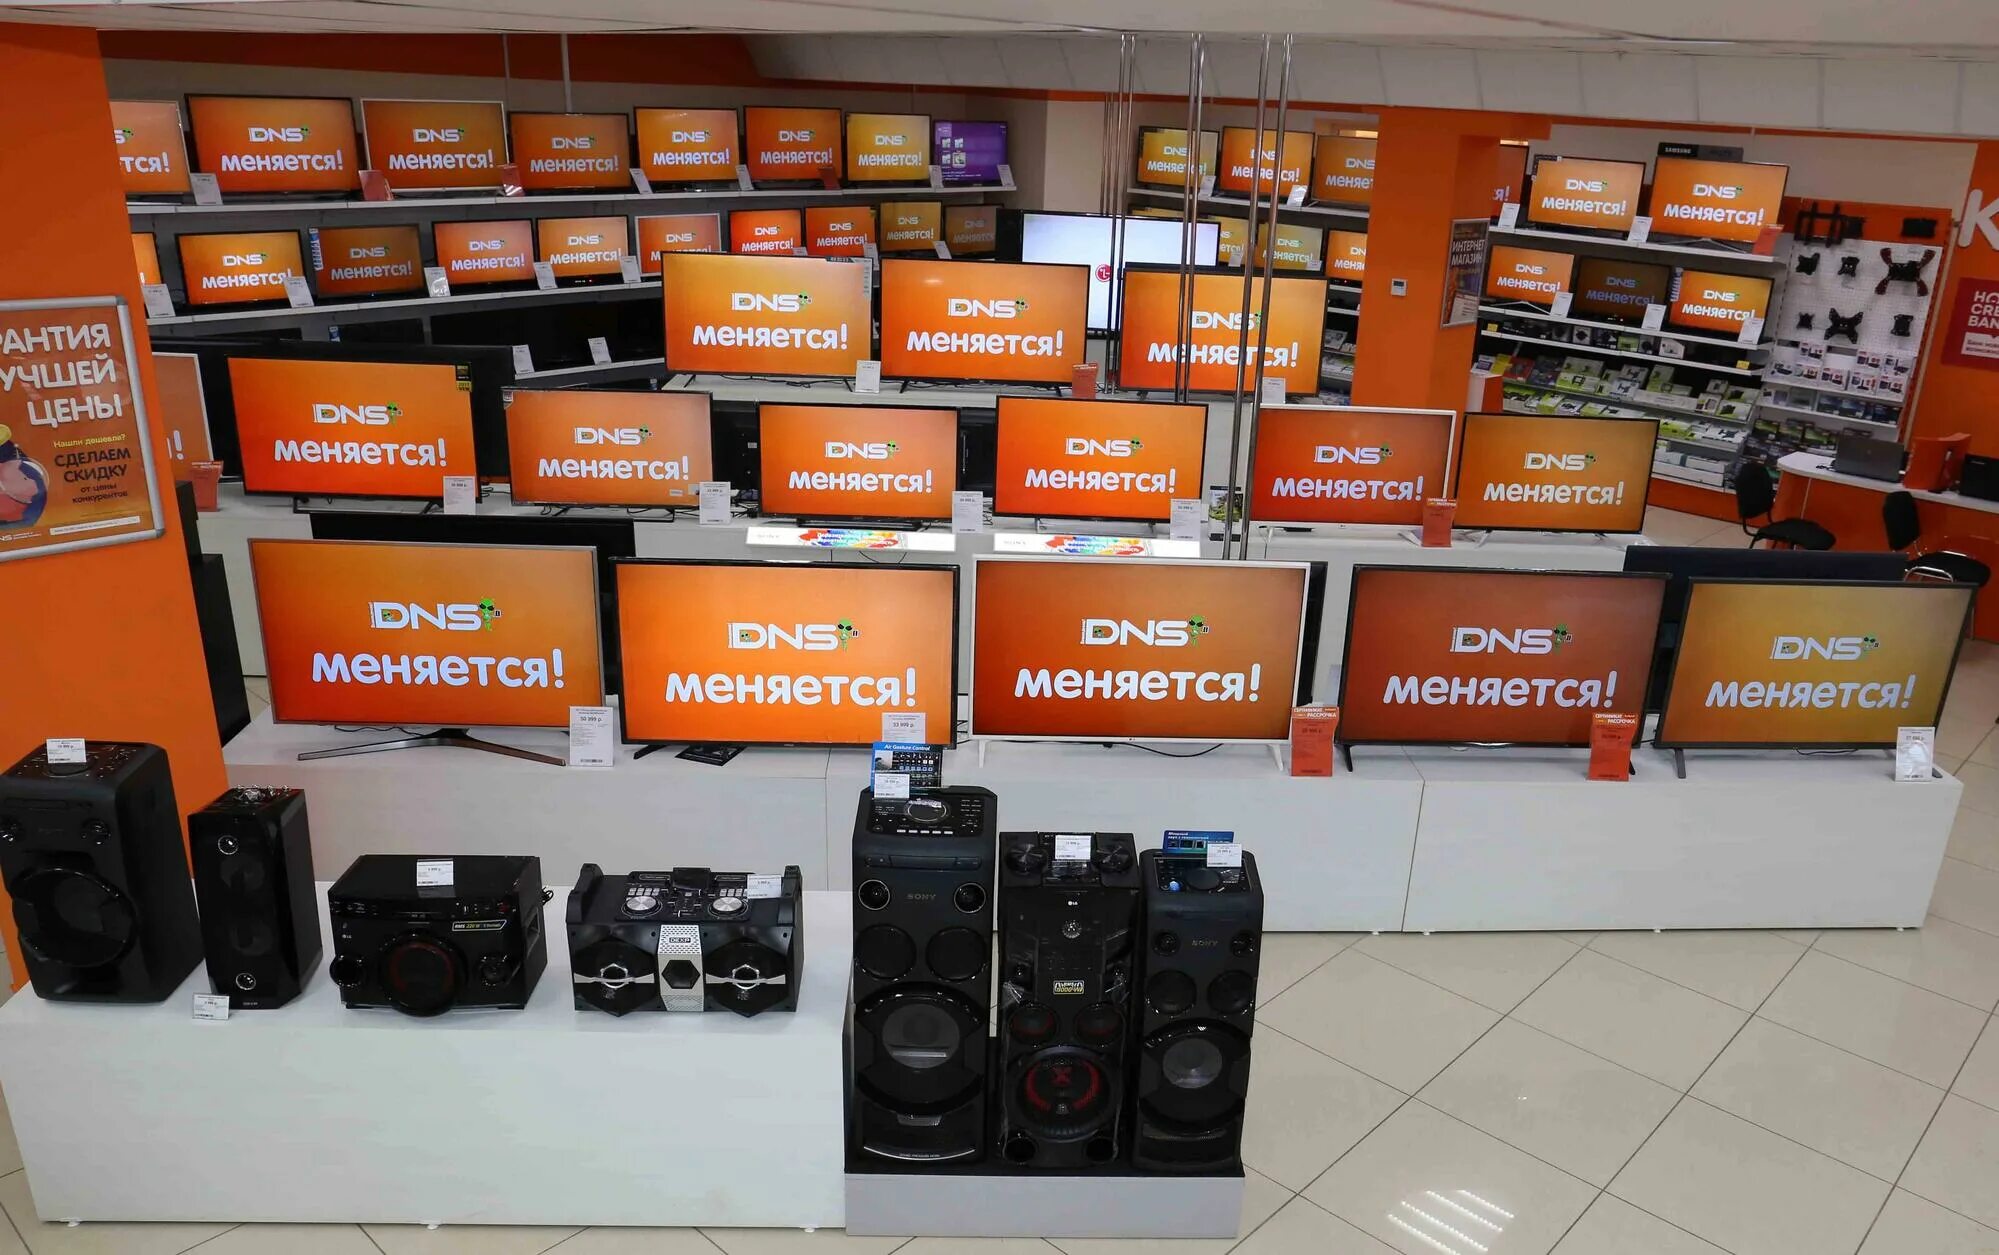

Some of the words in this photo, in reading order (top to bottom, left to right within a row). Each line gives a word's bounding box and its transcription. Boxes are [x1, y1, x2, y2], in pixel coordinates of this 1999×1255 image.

[248, 127, 303, 143] DNS
[413, 128, 460, 143] DNS
[552, 137, 591, 149] DNS
[671, 131, 705, 143] DNS
[778, 130, 810, 143] DNS
[875, 135, 905, 146] DNS
[222, 149, 343, 172] меняется!
[389, 149, 494, 170] меняется!
[530, 155, 619, 172] меняется!
[653, 148, 730, 166] меняется!
[760, 148, 833, 165] меняется!
[858, 151, 922, 167] меняется!
[1565, 178, 1603, 192] DNS
[1692, 184, 1736, 199] DNS
[1542, 196, 1627, 216] меняется!
[1663, 203, 1765, 226] меняется!
[754, 226, 778, 236] DNS
[829, 222, 852, 231] DNS
[469, 240, 501, 251] DNS
[568, 235, 600, 246] DNS
[666, 233, 693, 243] DNS
[222, 254, 264, 266] DNS
[350, 247, 386, 259] DNS
[451, 253, 525, 271] меняется!
[550, 248, 622, 265] меняется!
[331, 261, 412, 280] меняется!
[1515, 263, 1544, 275] DNS
[731, 292, 800, 312] DNS
[1703, 289, 1736, 302] DNS
[947, 298, 1016, 318] DNS
[692, 323, 847, 351] меняется!
[906, 330, 1063, 357] меняется!
[27, 393, 122, 428] ЦЕНЫ
[312, 403, 390, 425] DNS
[574, 427, 641, 446] DNS
[274, 437, 446, 467] меняется!
[825, 441, 888, 460] DNS
[1065, 437, 1132, 457] DNS
[1314, 444, 1382, 465] DNS
[54, 447, 131, 468] СДЕЛАЕМ
[1523, 452, 1586, 471] DNS
[63, 464, 127, 483] СКИДКУ
[538, 455, 689, 481] меняется!
[788, 468, 932, 494] меняется!
[1025, 468, 1176, 494] меняется!
[1272, 475, 1424, 502] меняется!
[1484, 481, 1624, 505] меняется!
[368, 601, 482, 631] DNS
[728, 622, 840, 650] DNS
[1080, 618, 1189, 646] DNS
[1450, 626, 1553, 654] DNS
[1769, 636, 1863, 660] DNS
[312, 648, 564, 689] меняется!
[665, 667, 917, 707] меняется!
[1014, 663, 1261, 702] меняется!
[1383, 670, 1617, 708] меняется!
[1705, 674, 1916, 709] меняется!
[906, 893, 937, 901] SONY
